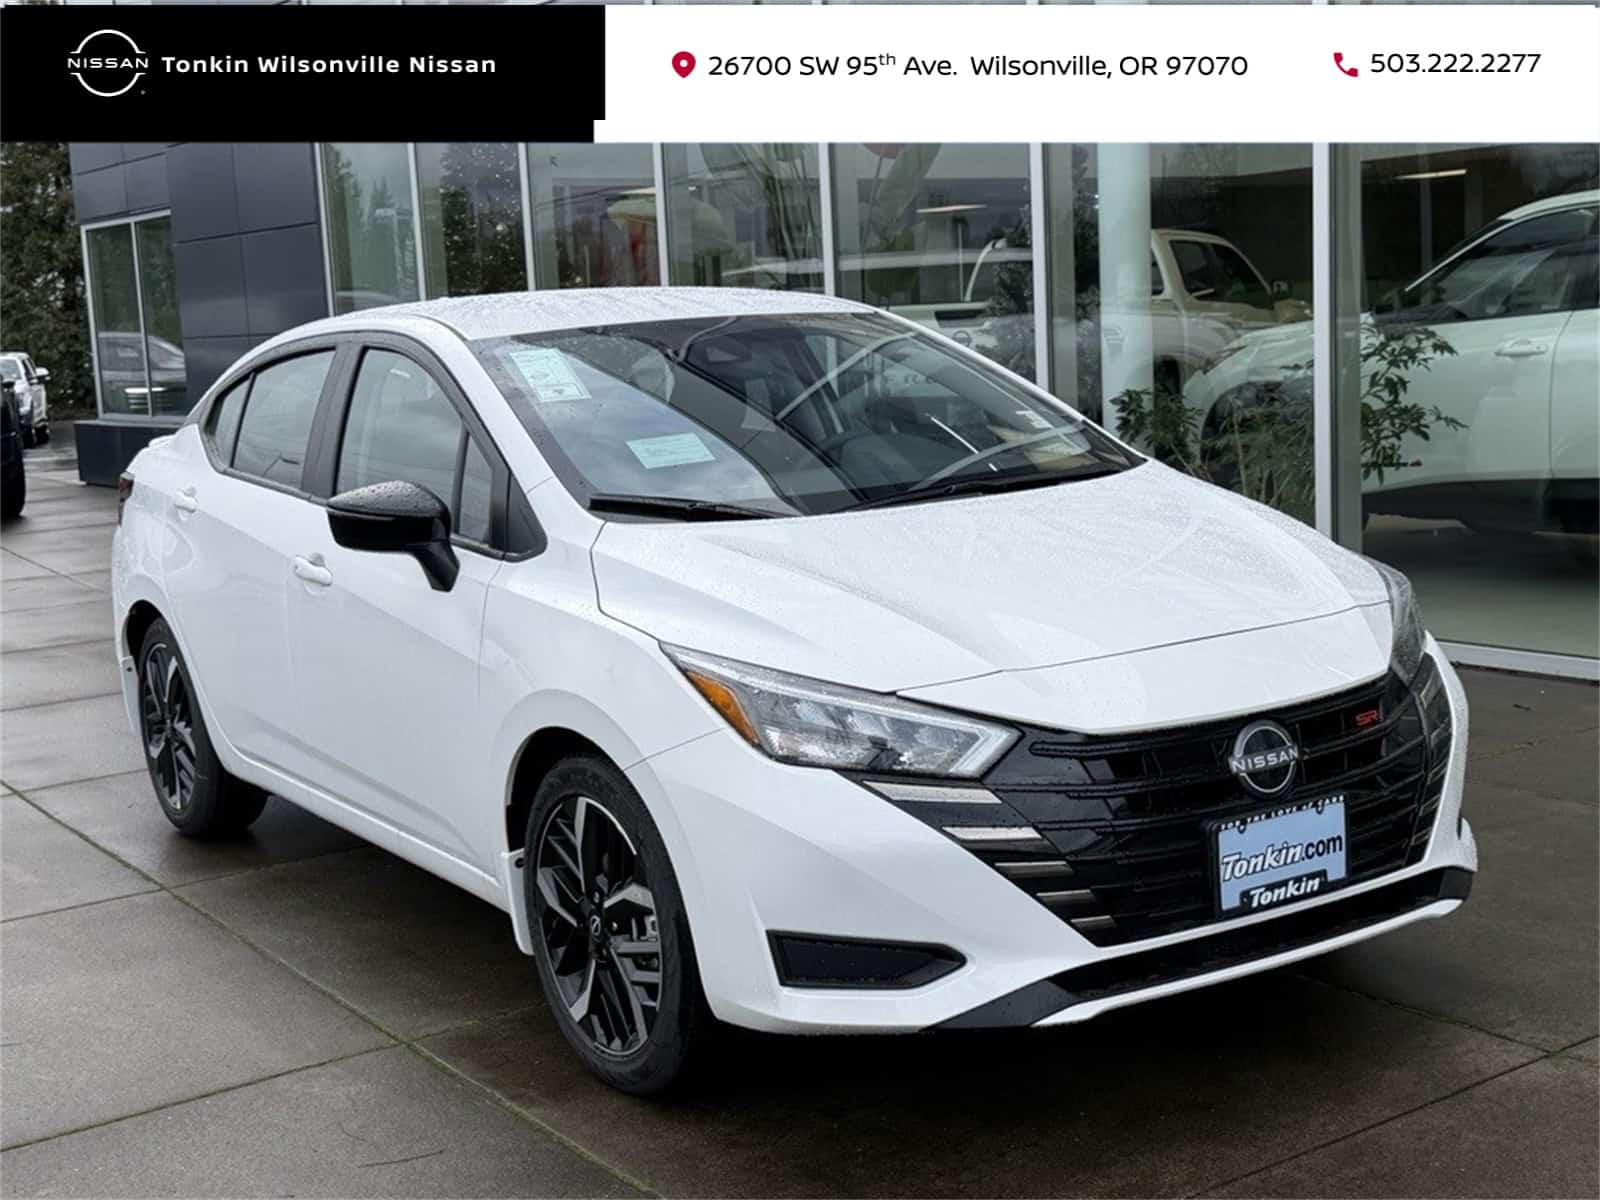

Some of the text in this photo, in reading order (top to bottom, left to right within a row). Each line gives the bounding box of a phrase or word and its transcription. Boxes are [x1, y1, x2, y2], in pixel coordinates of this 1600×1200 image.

[1355, 710, 1378, 727] SR
[1231, 746, 1299, 773] NISSAN
[1221, 834, 1344, 882] Tonkin.com
[1249, 876, 1321, 908] Tonkin
